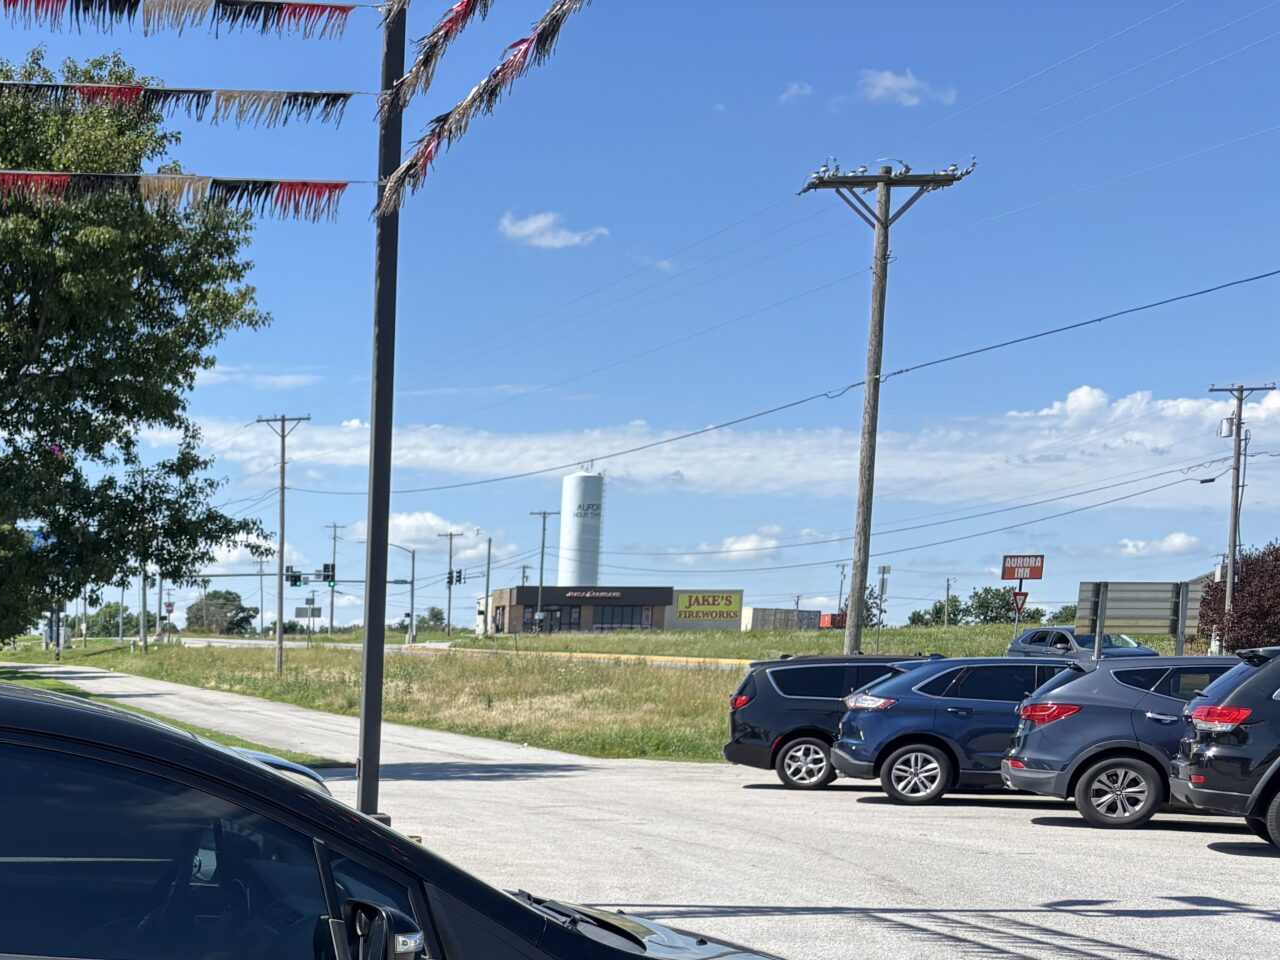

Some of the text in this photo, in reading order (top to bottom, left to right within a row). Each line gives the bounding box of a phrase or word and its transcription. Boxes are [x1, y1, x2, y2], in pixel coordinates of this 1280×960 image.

[1005, 557, 1041, 567] AURORA
[1014, 567, 1030, 578] INN
[685, 595, 732, 608] JAKE'S
[678, 610, 738, 619] FIREWORKS
